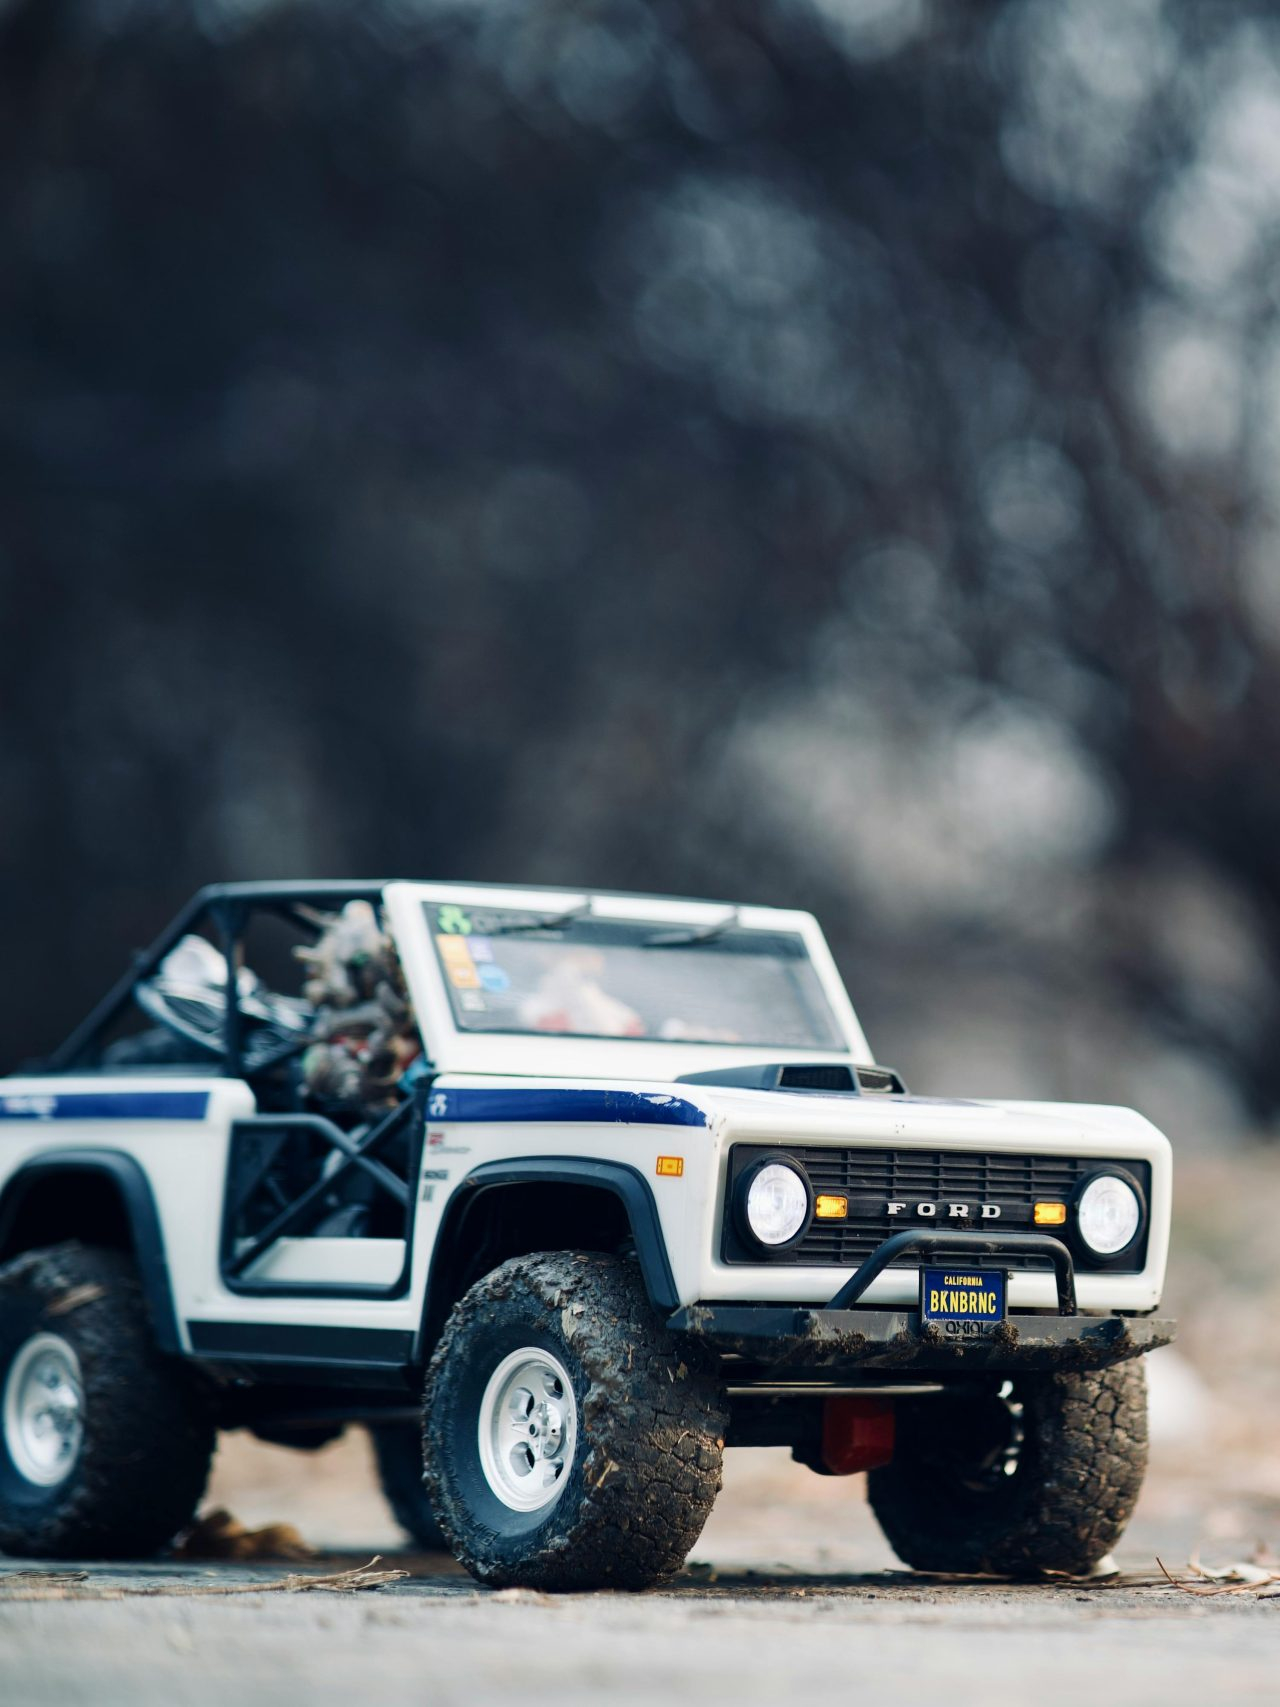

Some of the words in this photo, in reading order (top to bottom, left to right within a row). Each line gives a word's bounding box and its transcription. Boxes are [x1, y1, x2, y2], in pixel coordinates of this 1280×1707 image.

[887, 1202, 1001, 1219] FORD
[944, 1275, 983, 1287] CALIFORNIA
[930, 1290, 996, 1314] BKNBRNC
